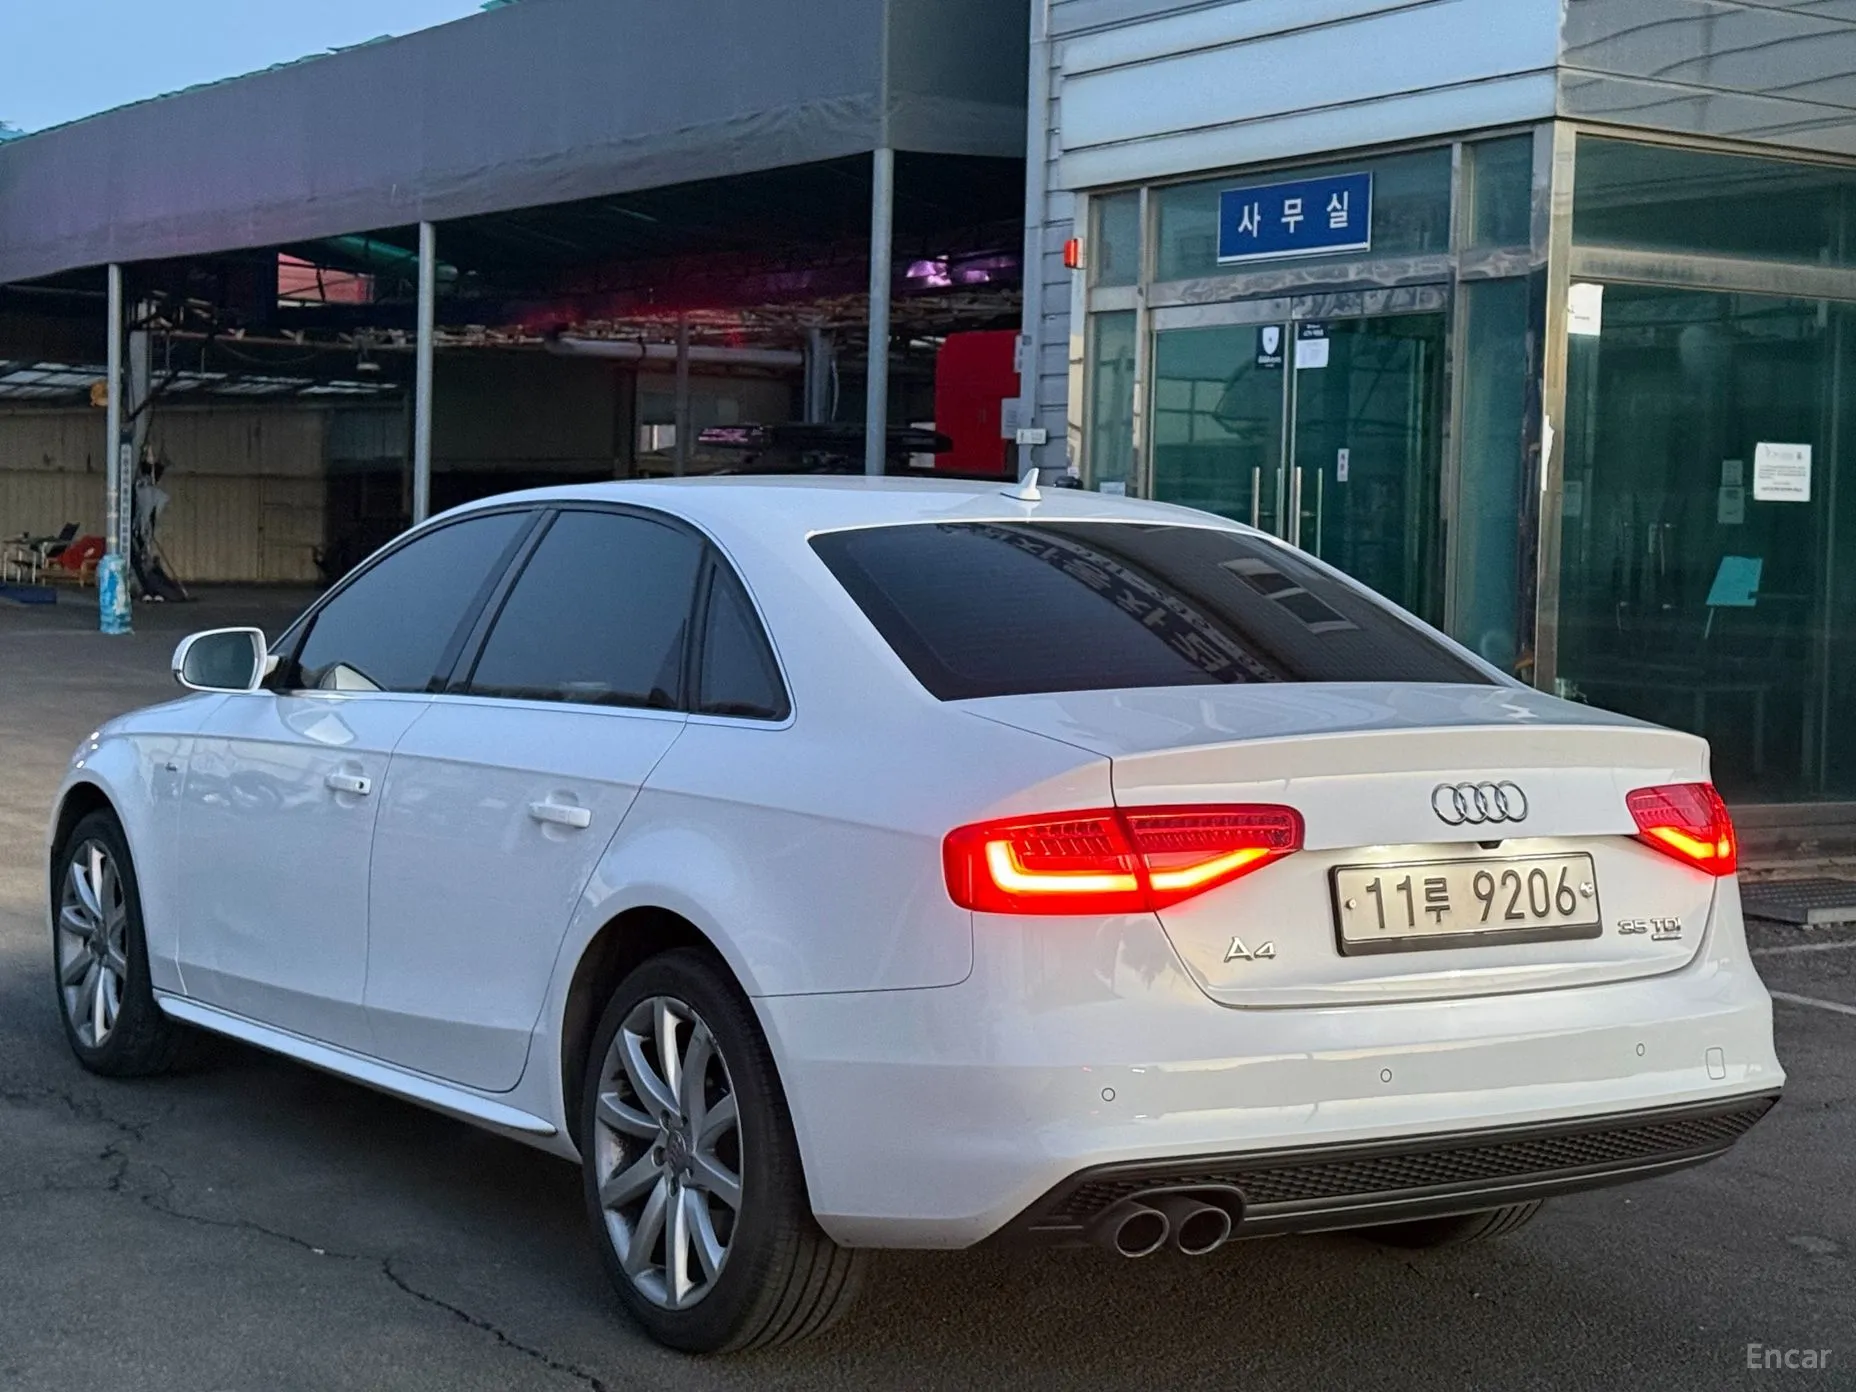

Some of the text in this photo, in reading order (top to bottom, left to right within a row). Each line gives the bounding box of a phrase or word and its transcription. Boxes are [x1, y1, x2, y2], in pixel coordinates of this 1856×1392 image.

[1365, 866, 1577, 930] 11루 9206
[1649, 917, 1681, 932] TDI
[1223, 936, 1277, 963] A4
